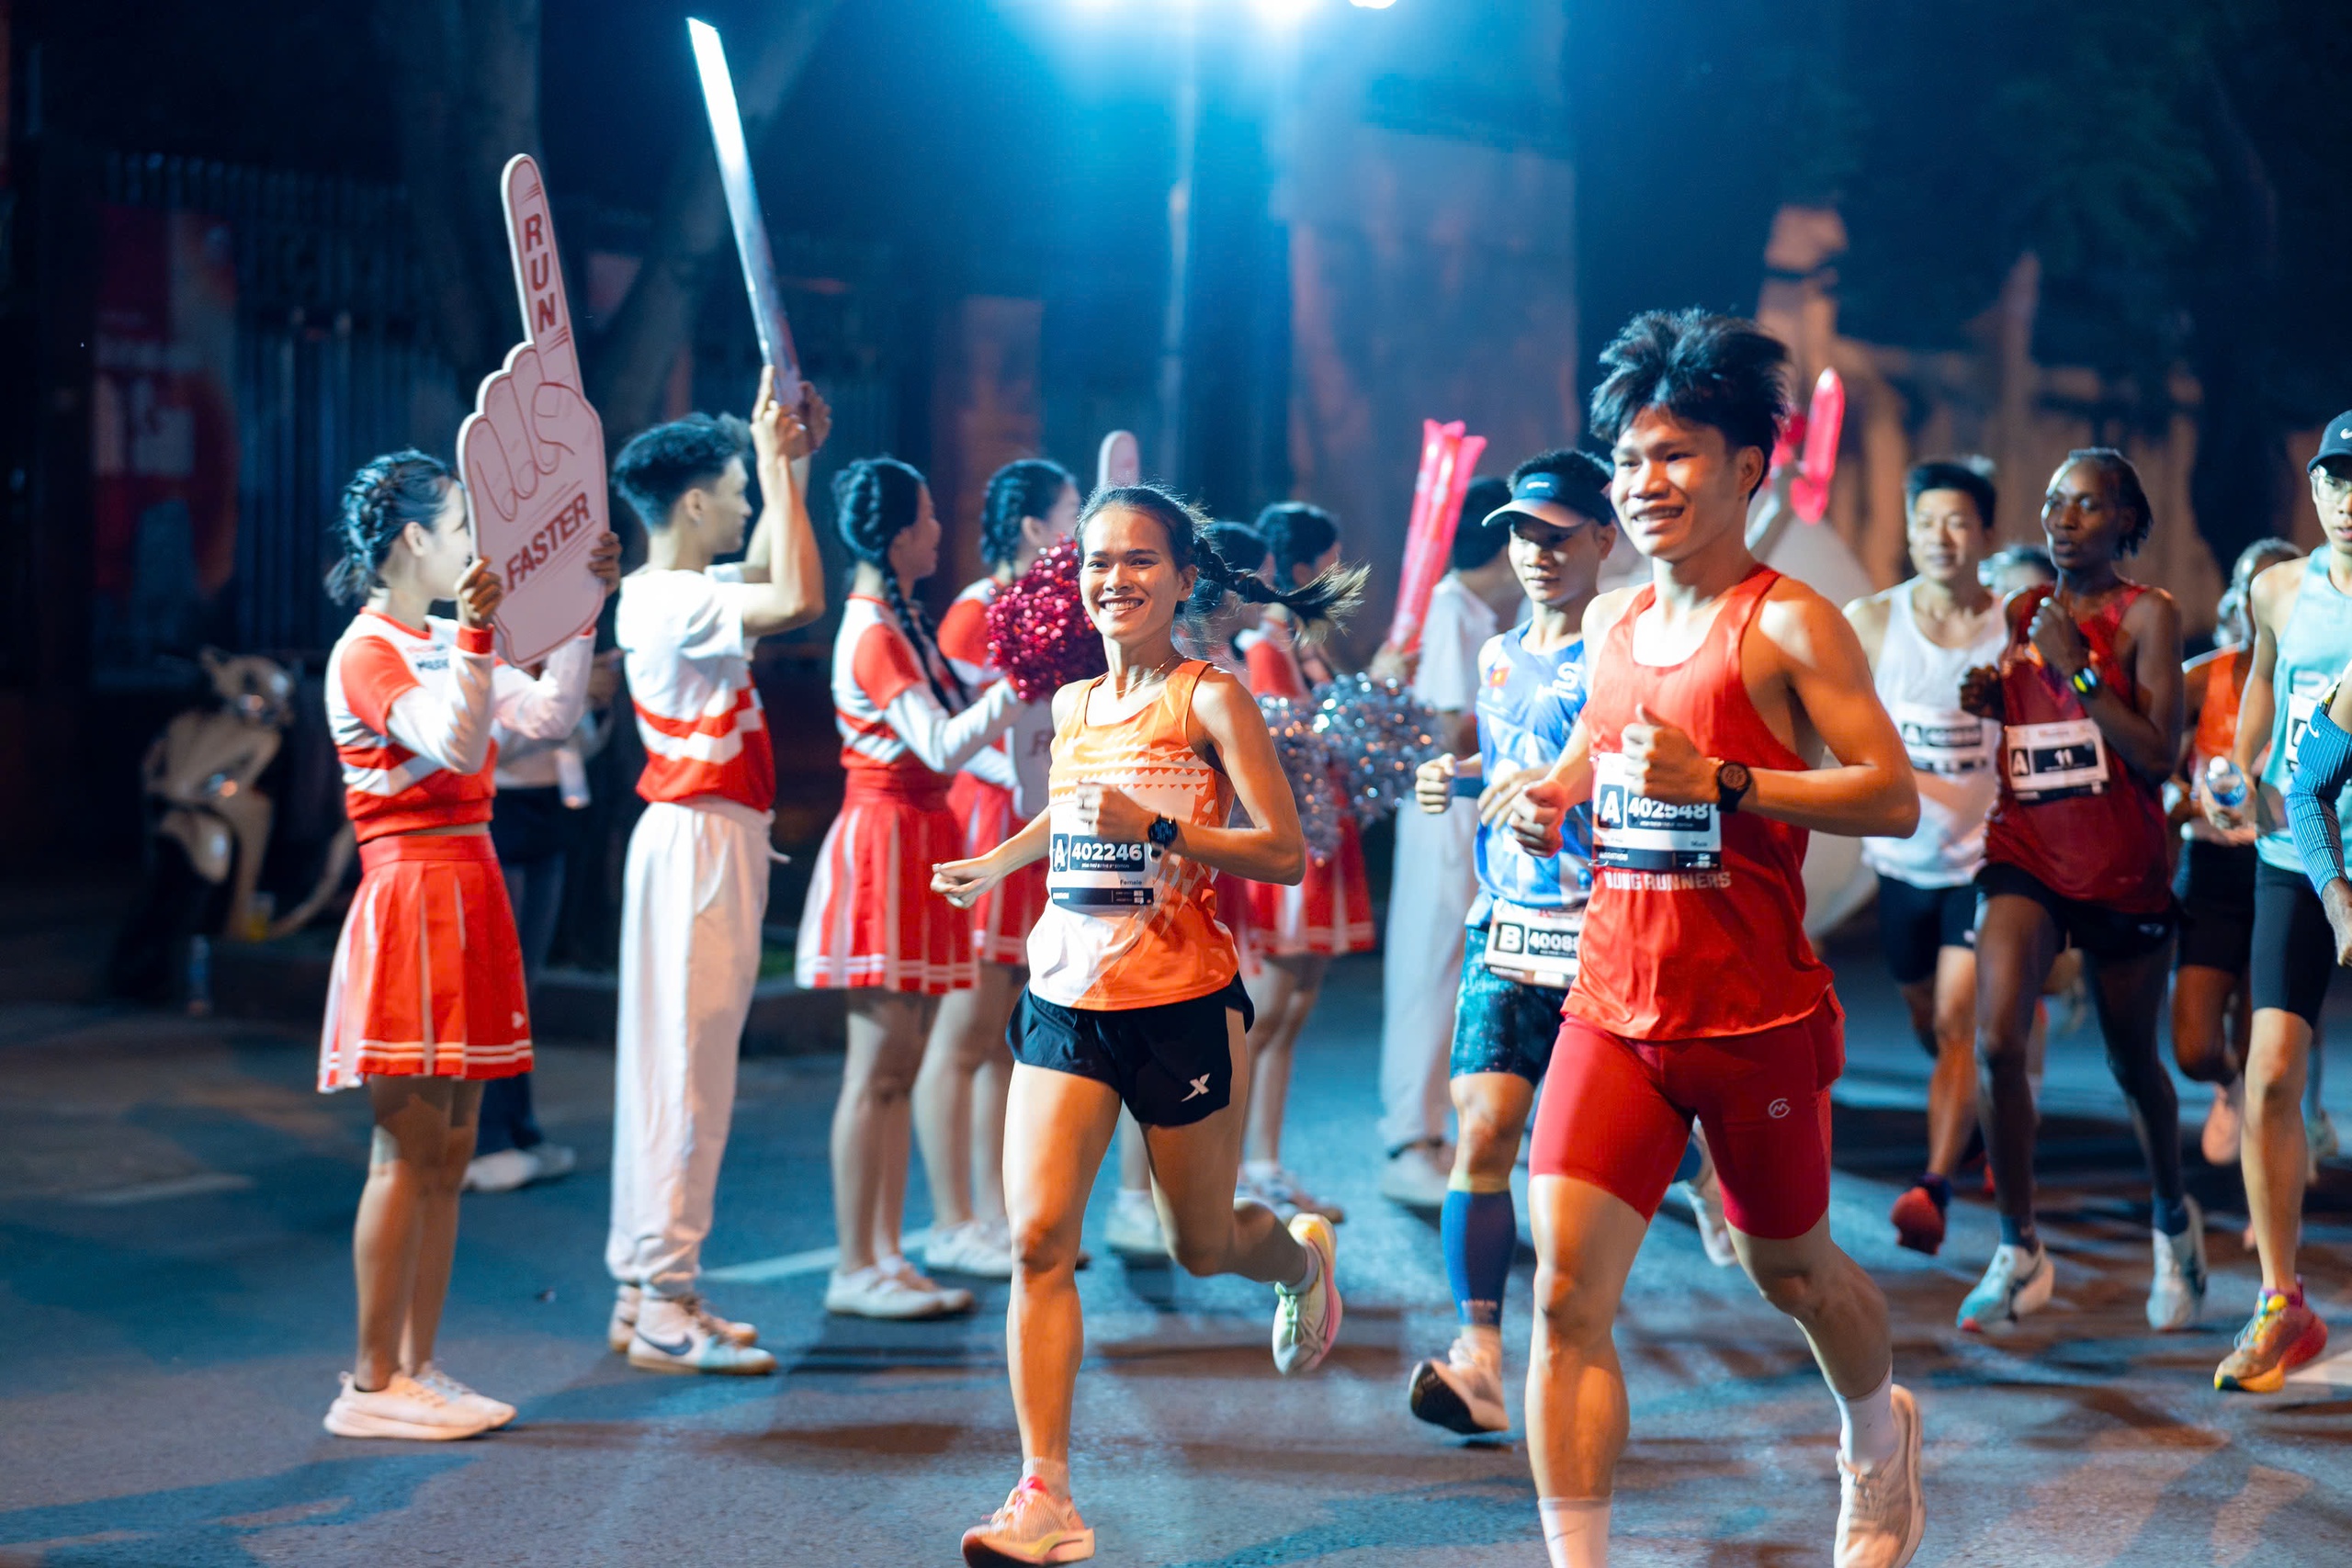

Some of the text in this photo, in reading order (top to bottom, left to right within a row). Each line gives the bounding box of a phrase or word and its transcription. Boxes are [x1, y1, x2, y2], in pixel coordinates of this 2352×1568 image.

[524, 212, 557, 333] RUN
[505, 492, 591, 592] FASTER
[2012, 750, 2030, 774] A
[1600, 791, 1622, 824] A
[1628, 797, 1708, 819] 402548
[1054, 839, 1066, 867] A
[1071, 842, 1142, 861] 402246
[1644, 872, 1731, 891] RUNNERS
[1498, 924, 1521, 952] B
